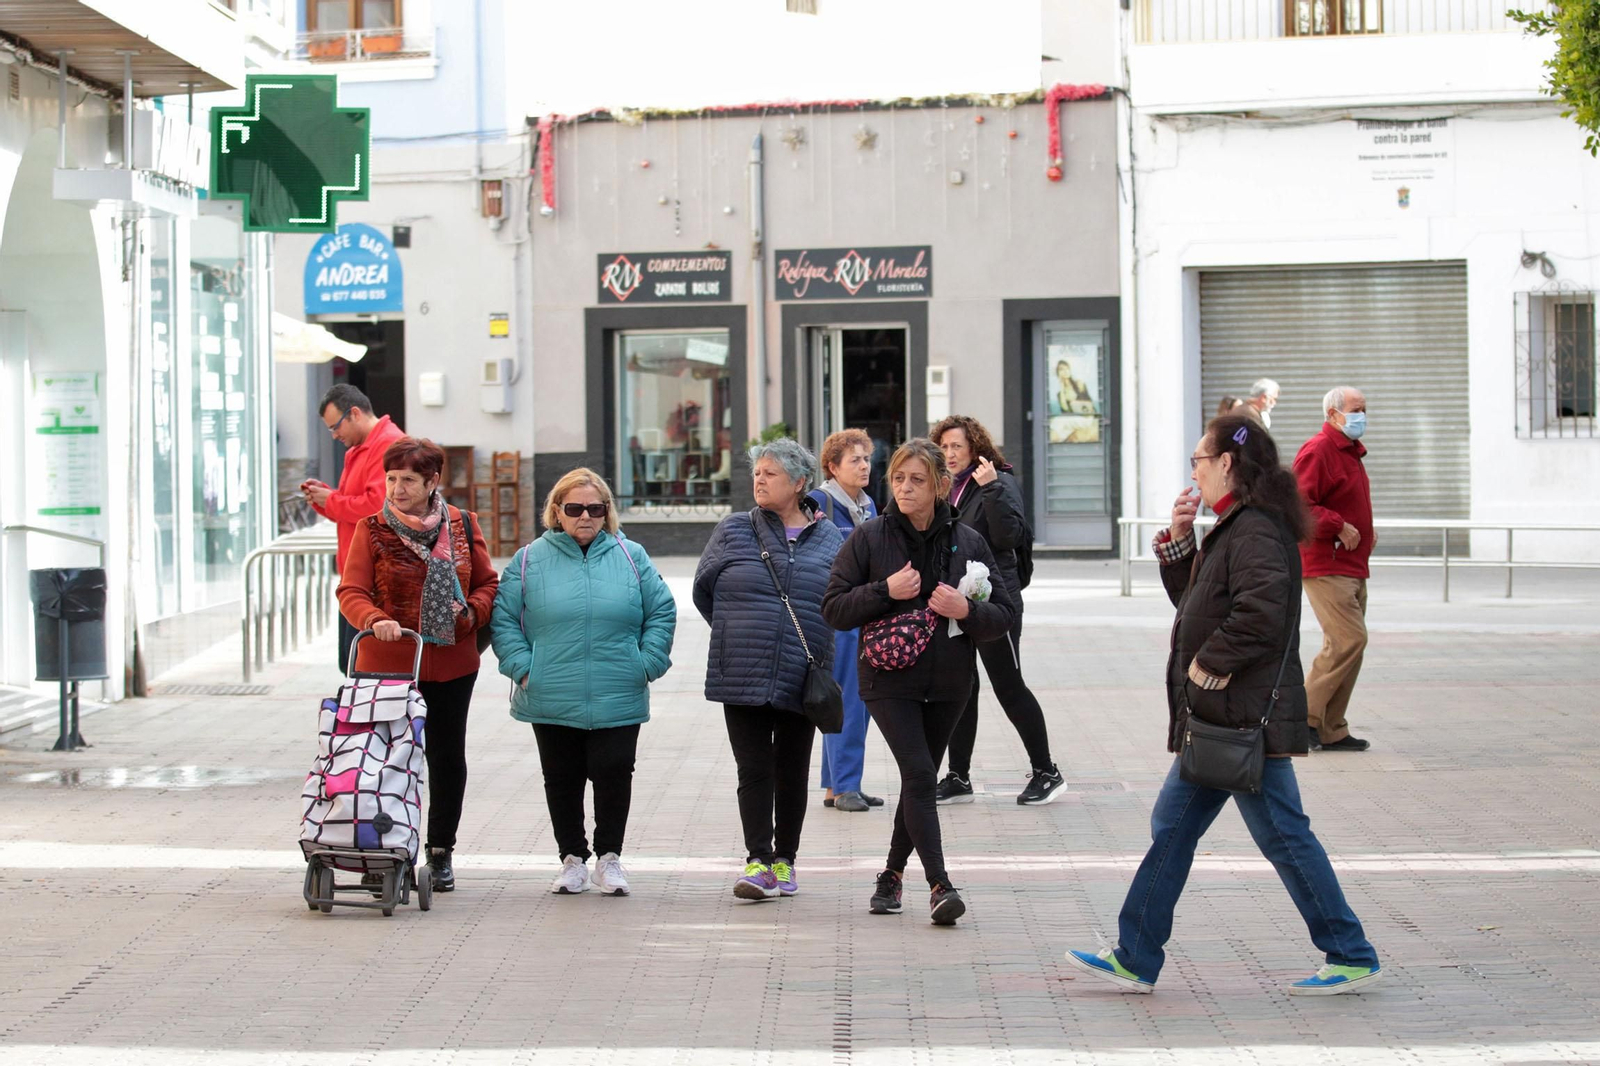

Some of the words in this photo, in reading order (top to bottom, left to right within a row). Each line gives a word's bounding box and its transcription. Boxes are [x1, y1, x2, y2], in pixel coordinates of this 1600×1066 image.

[1374, 133, 1398, 144] contra
[1401, 132, 1408, 143] la
[1410, 131, 1431, 145] pared
[359, 234, 384, 256] BAR
[315, 262, 389, 287] ANDREA
[647, 257, 726, 273] COMPLEMENTOS
[834, 257, 871, 290] RM
[872, 249, 928, 281] Morales
[602, 263, 641, 295] RM
[420, 302, 430, 315] 6
